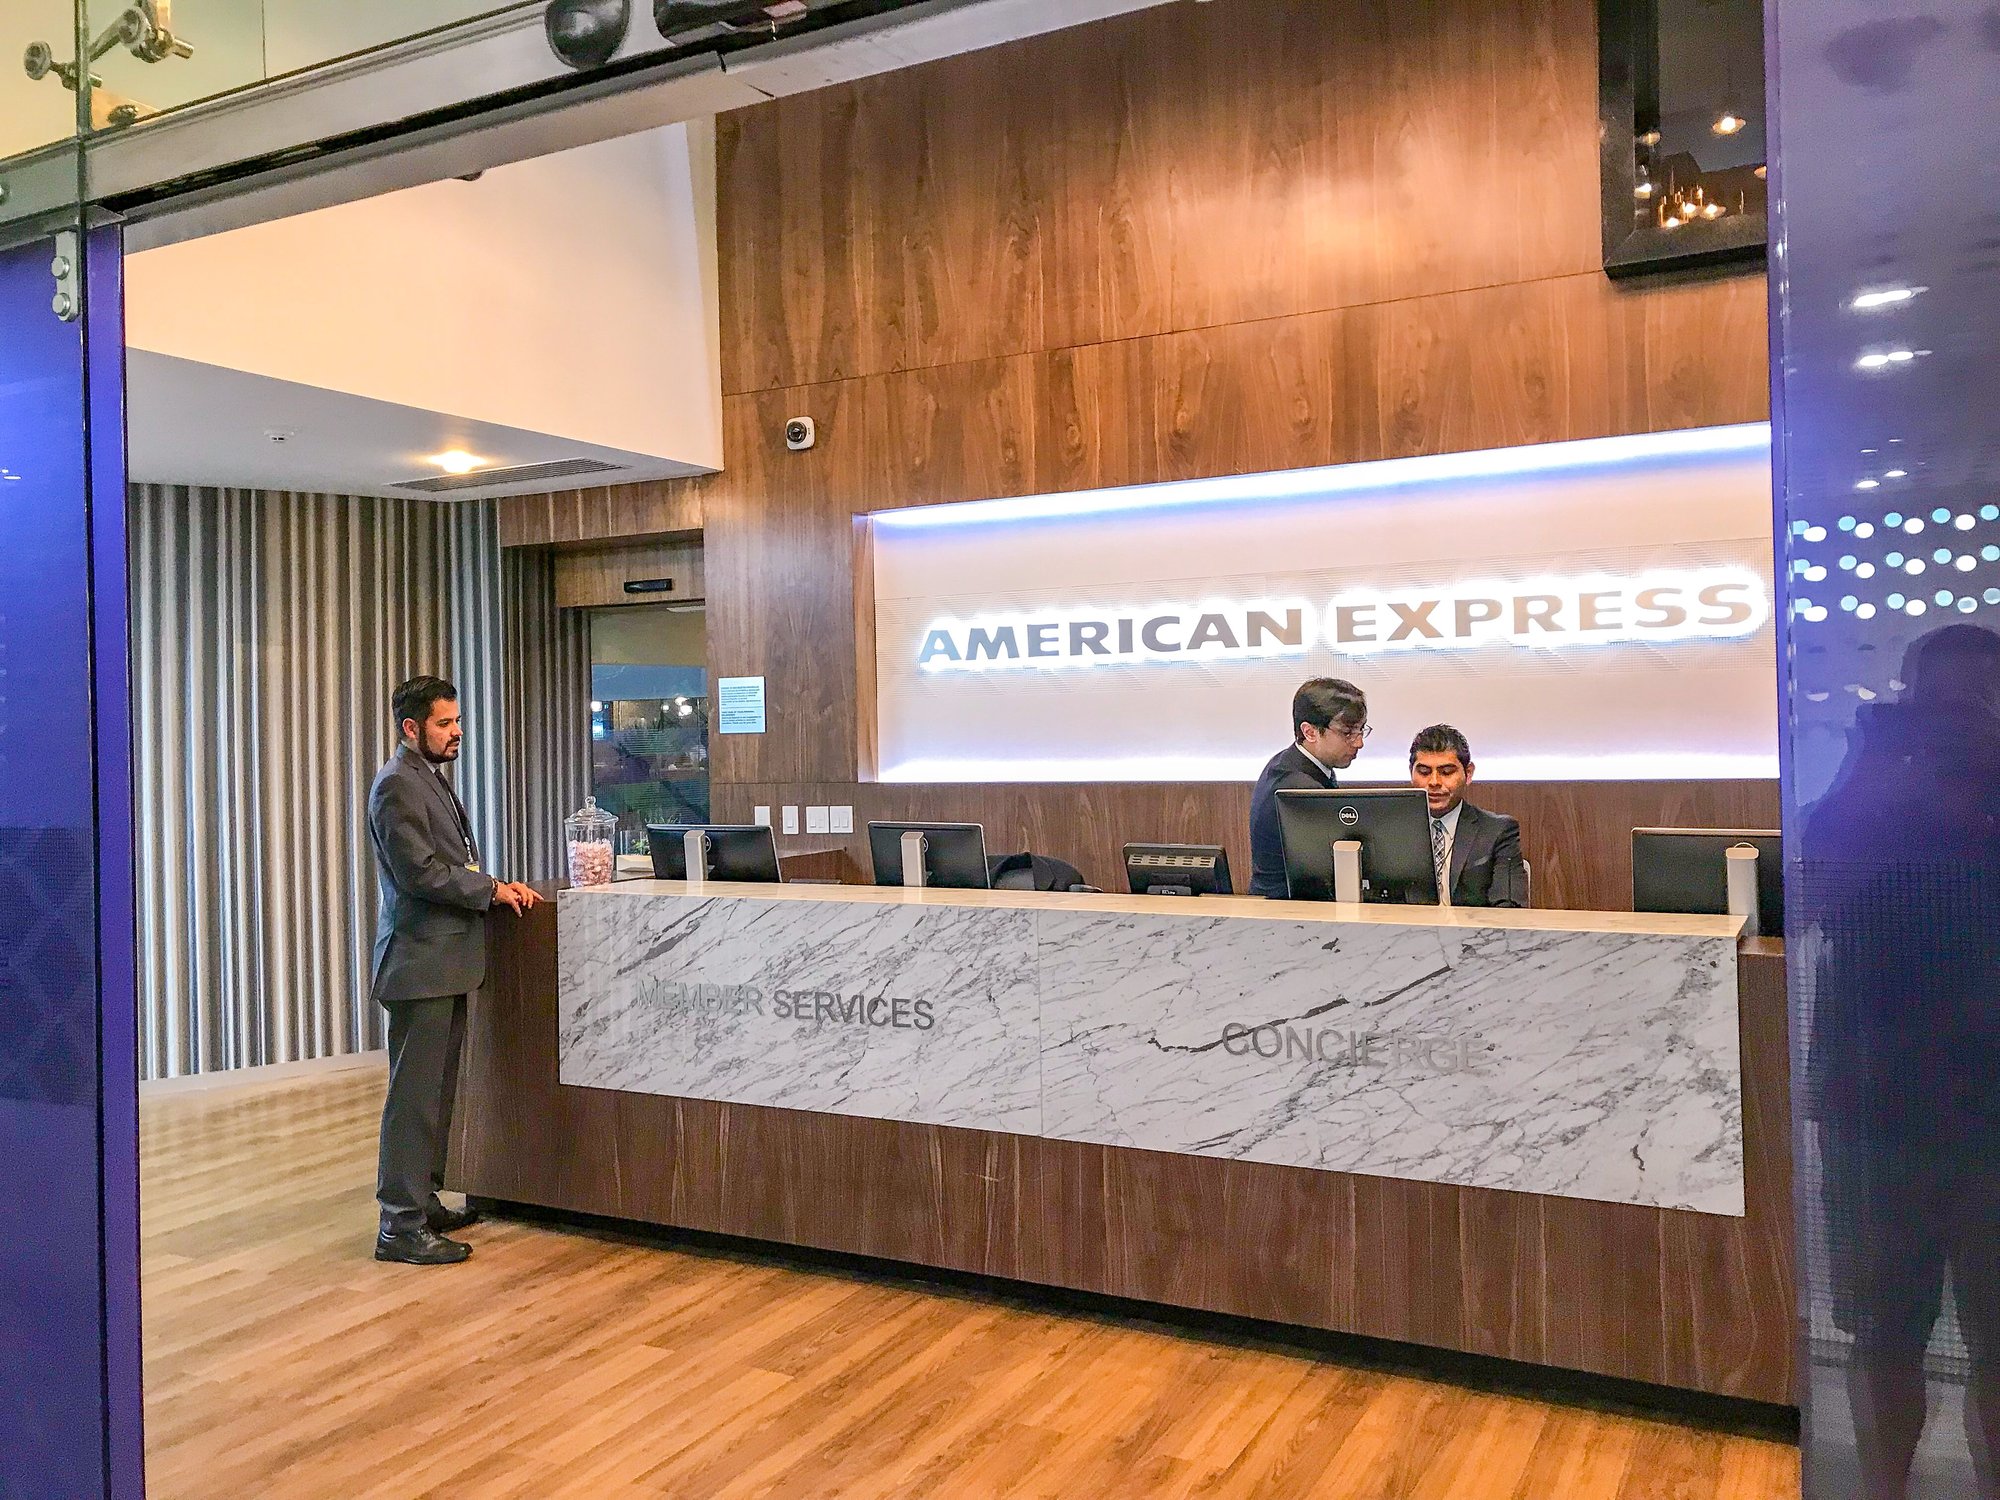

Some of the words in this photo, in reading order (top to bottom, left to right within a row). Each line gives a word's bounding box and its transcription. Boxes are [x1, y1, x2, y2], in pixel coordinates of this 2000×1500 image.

[919, 608, 1303, 662] AMERICAN
[1336, 584, 1754, 642] EXPRESS
[636, 977, 764, 1016] MEMBER
[773, 990, 935, 1030] SERVICES
[1222, 1022, 1490, 1075] CONCIERGE
